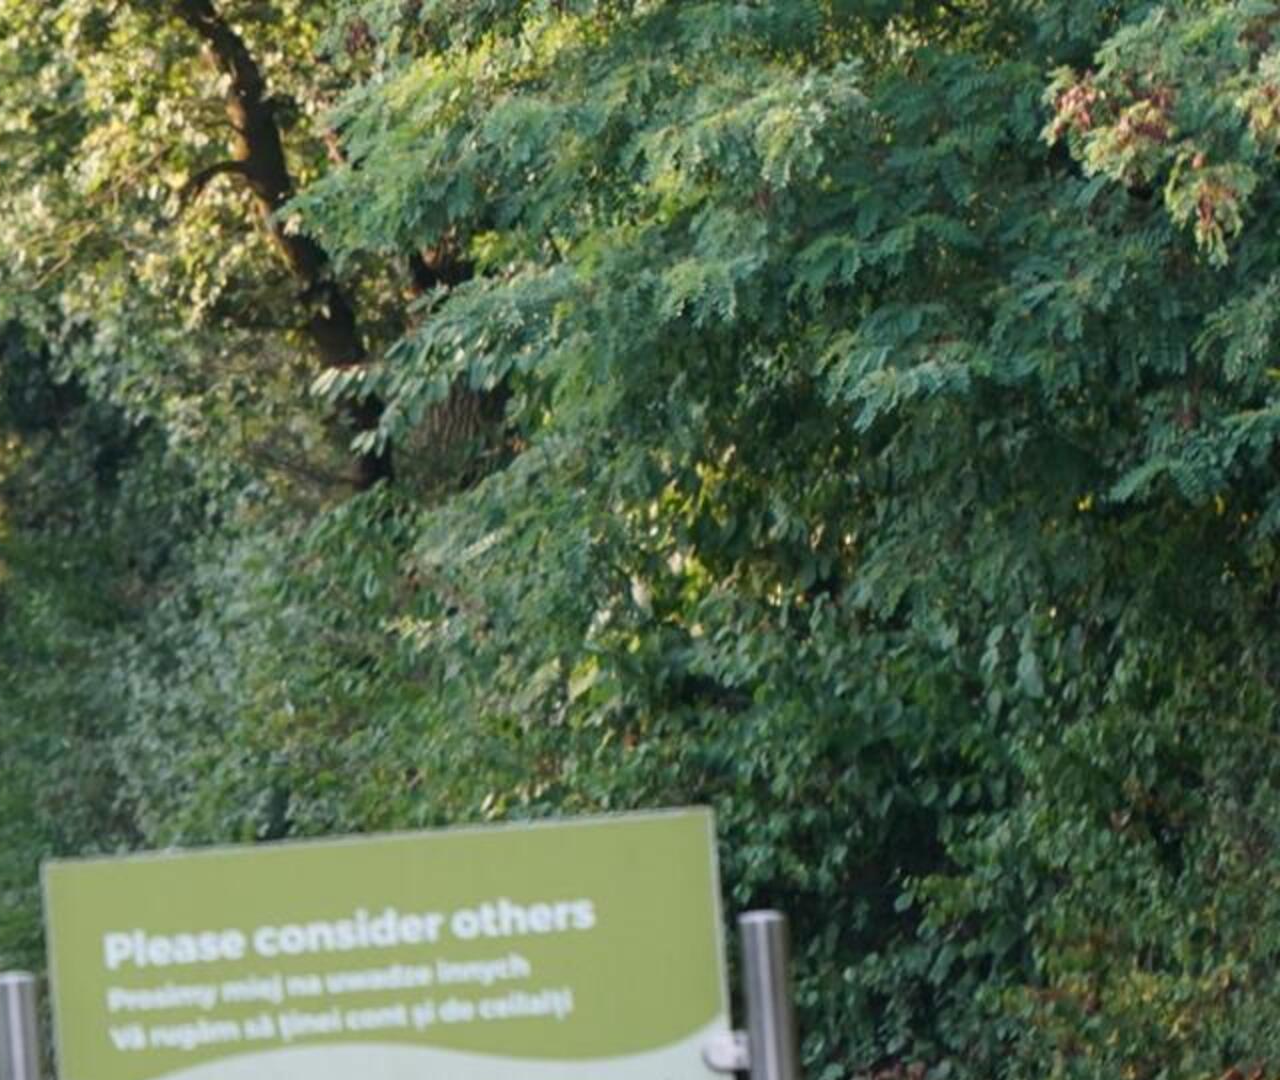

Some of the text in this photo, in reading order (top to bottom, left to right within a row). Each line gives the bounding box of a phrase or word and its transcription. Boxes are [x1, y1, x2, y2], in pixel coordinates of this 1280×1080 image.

[104, 898, 596, 970] Please consider others
